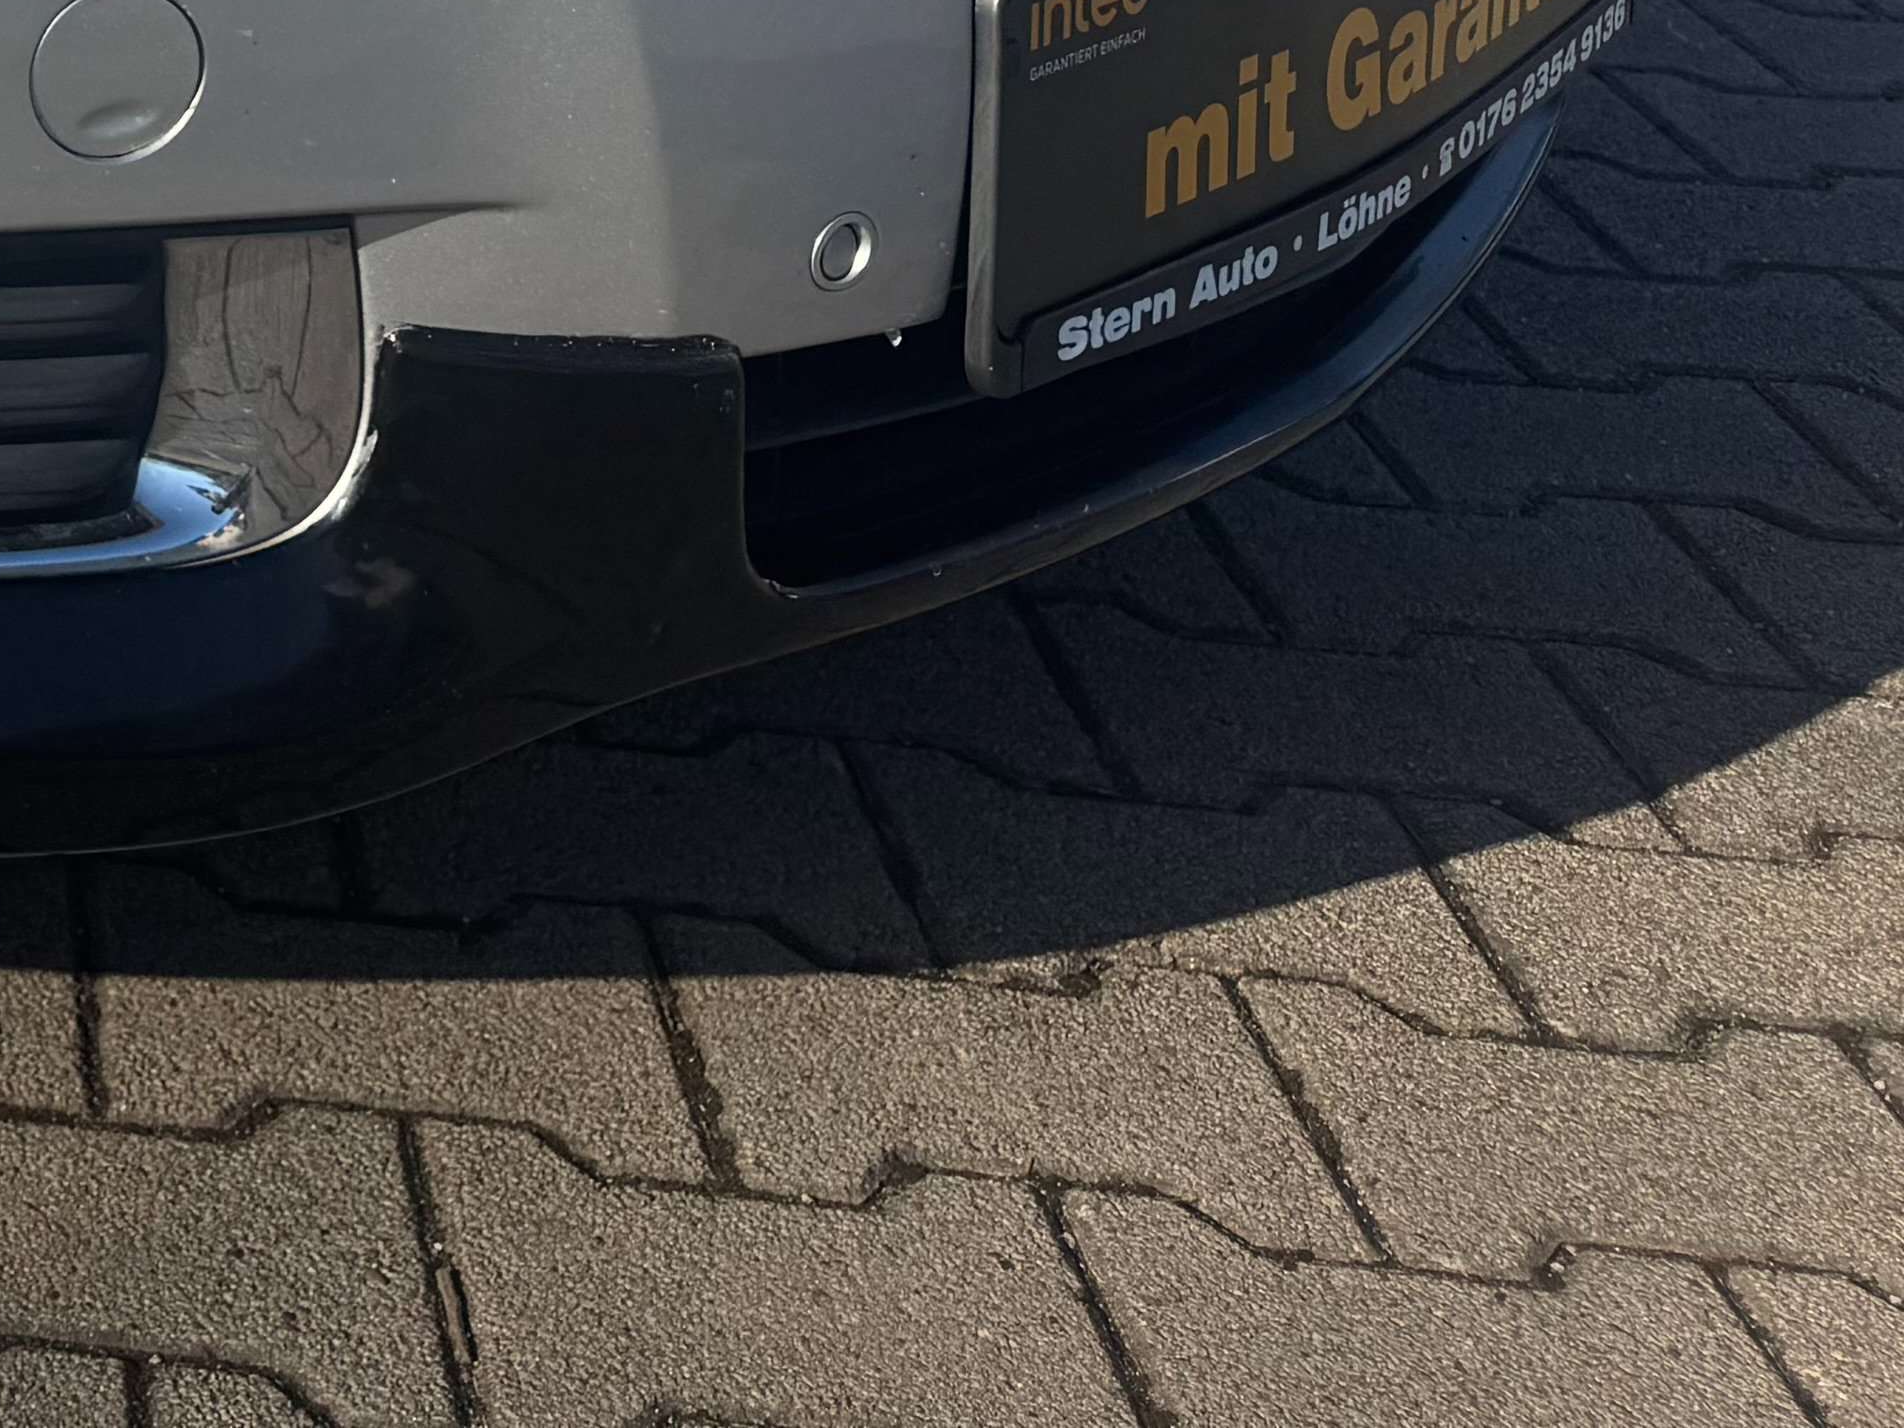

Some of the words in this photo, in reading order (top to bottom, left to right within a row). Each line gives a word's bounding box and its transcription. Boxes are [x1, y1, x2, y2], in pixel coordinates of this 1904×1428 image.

[1028, 42, 1099, 82] GARANTIERT
[1099, 27, 1147, 57] EINFACH
[1145, 48, 1297, 218] mit
[1057, 287, 1176, 361] Stern
[1188, 245, 1279, 309] Auto
[1317, 174, 1412, 251] Löhne
[1458, 88, 1518, 160] 0176
[1520, 37, 1578, 114] 2354
